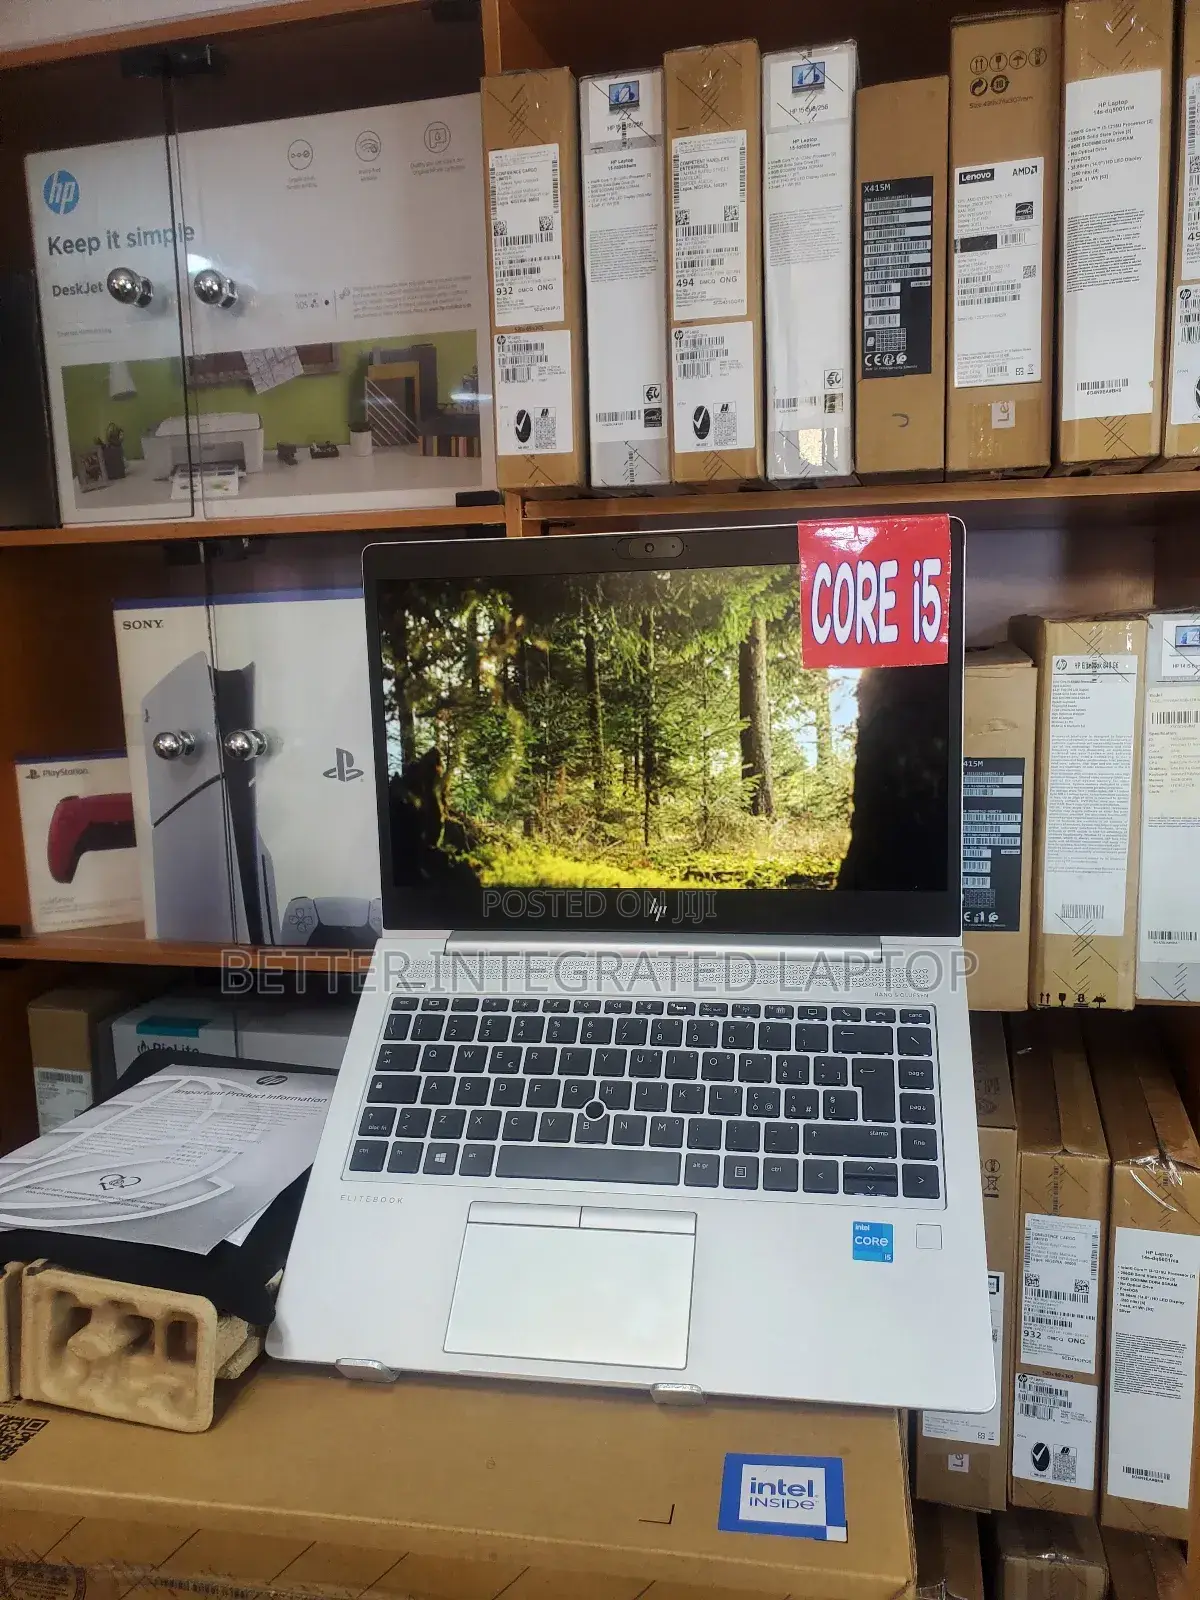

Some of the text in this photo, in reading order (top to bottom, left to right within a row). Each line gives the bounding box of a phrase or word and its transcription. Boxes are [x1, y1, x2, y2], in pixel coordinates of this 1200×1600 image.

[961, 166, 1031, 182] Lenovo AMD
[48, 170, 76, 216] hp
[864, 184, 891, 192] X415M
[48, 223, 195, 257] Keep it simple
[676, 278, 694, 287] 494
[52, 281, 104, 298] DeskJet
[496, 286, 514, 296] 932
[811, 558, 942, 645] CORE i5
[122, 619, 164, 631] SONY
[42, 768, 90, 778] PlayStation
[566, 1052, 572, 1060] T
[174, 1089, 328, 1104] Important Product Information
[620, 1121, 628, 1129] N
[658, 1123, 666, 1131] M
[340, 1194, 404, 1204] ELITEBOOK
[854, 1224, 870, 1232] intel
[854, 1236, 889, 1247] CORE
[1023, 1330, 1086, 1345] 932 ONG
[750, 1476, 814, 1498] intel
[749, 1497, 816, 1510] INSIDE
